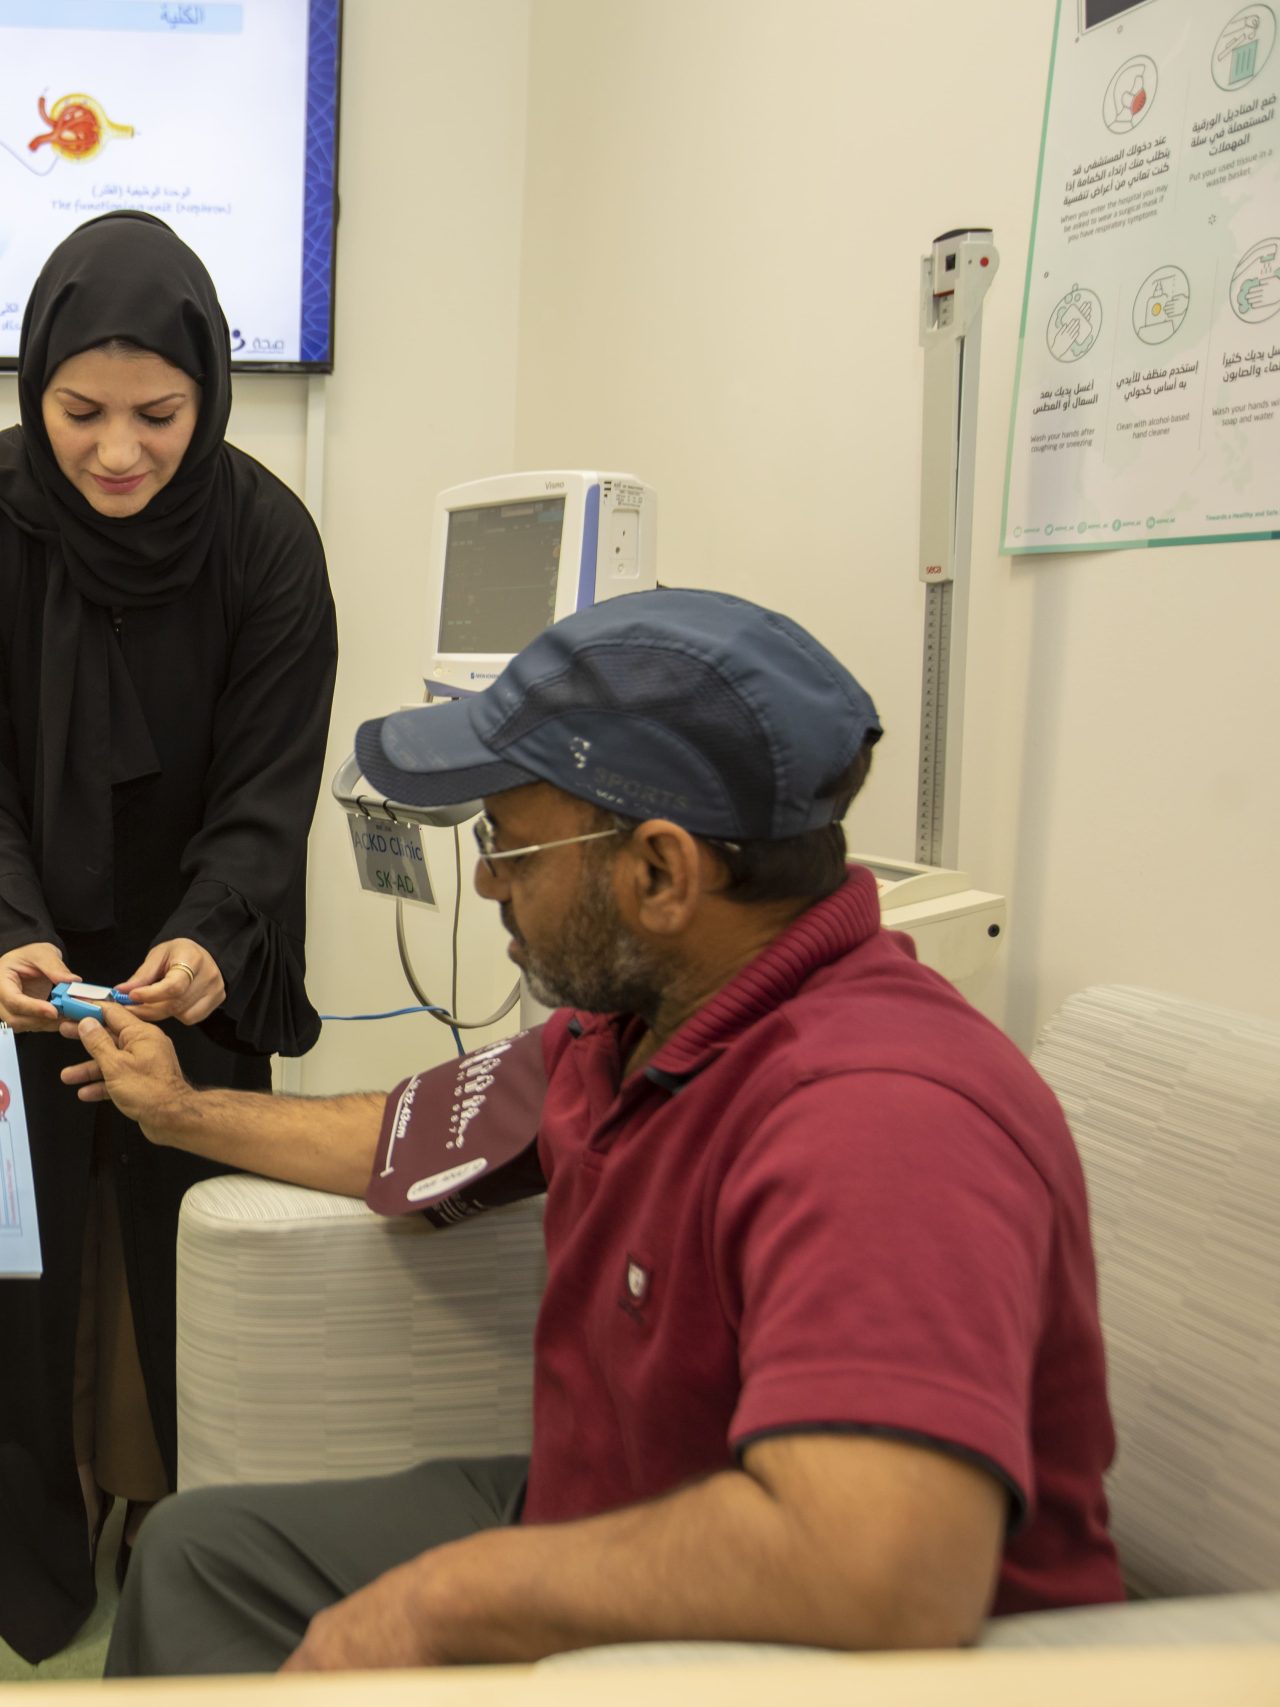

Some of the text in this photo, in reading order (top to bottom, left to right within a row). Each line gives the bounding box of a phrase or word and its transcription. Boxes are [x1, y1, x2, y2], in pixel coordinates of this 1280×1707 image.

[160, 3, 204, 30] الكلية
[1223, 98, 1259, 123] المناديل
[1191, 108, 1274, 147] المستعملة في سلة
[1192, 112, 1221, 133] الورقية
[1126, 142, 1152, 157] دخولك
[1154, 136, 1167, 147] عند
[1209, 133, 1250, 156] المهملات
[1072, 163, 1082, 176] قد
[1128, 157, 1144, 170] منك
[1151, 162, 1169, 177] كنت
[1189, 172, 1201, 182] Put
[1202, 167, 1217, 179] your
[1218, 161, 1235, 172] used
[1237, 153, 1258, 166] tissue
[1077, 169, 1106, 188] الكمامة
[1115, 179, 1126, 191] من
[1205, 167, 1251, 188] waste basket
[1063, 190, 1089, 207] تنفسية
[1078, 210, 1089, 220] you
[1090, 204, 1106, 214] enter
[1107, 200, 1117, 209] the
[1118, 191, 1141, 206] hospital
[1142, 188, 1154, 200] you
[1155, 183, 1169, 193] may
[1098, 212, 1112, 222] wear
[1119, 203, 1141, 217] surgical
[1141, 197, 1158, 209] mask
[1068, 233, 1079, 244] you
[1079, 229, 1094, 239] have
[1094, 219, 1126, 234] respiratory
[1244, 350, 1265, 362] يديك
[1142, 368, 1167, 381] منظف
[1223, 364, 1261, 383] والصابون
[1040, 391, 1053, 399] بعد
[1054, 386, 1072, 398] يديك
[1124, 384, 1151, 402] كحولي
[1032, 393, 1099, 415] السعال أو العطس
[1231, 404, 1246, 415] your
[1248, 400, 1269, 410] hands
[1116, 422, 1133, 431] Clean
[1133, 419, 1147, 429] with
[1222, 412, 1274, 426] soap and water
[1030, 428, 1095, 443] Wash your hands after
[1132, 428, 1170, 439] hand cleaner
[1031, 443, 1058, 453] coughing
[1065, 439, 1093, 449] sneezing
[389, 836, 423, 861] Clinic
